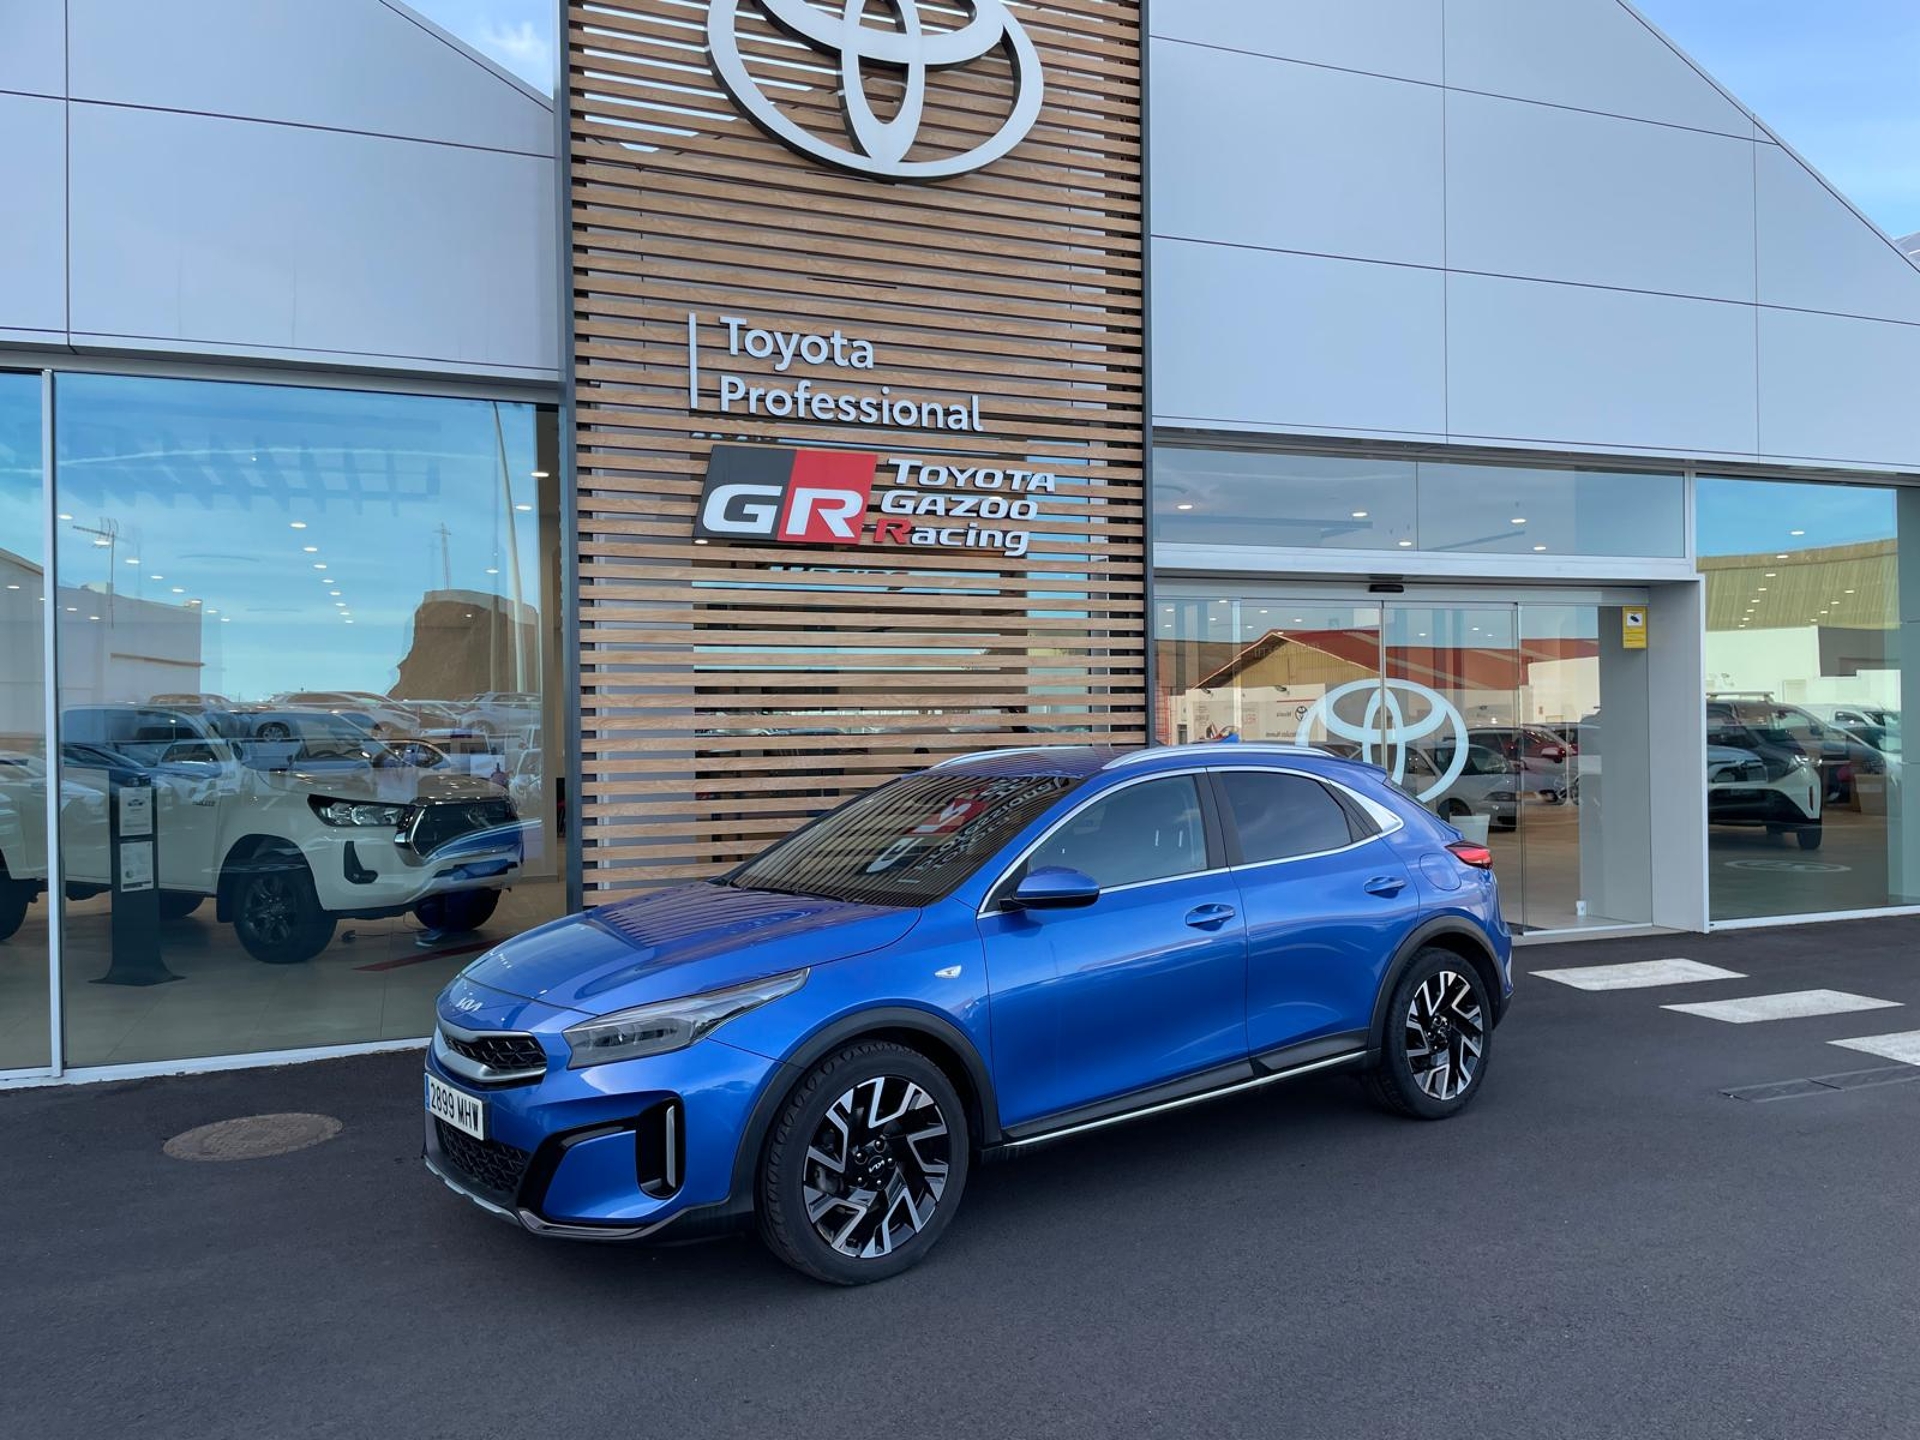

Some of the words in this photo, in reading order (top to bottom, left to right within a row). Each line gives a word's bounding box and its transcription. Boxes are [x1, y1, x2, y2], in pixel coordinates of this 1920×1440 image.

[719, 316, 875, 372] Toyota
[719, 375, 984, 432] Professional
[887, 458, 1056, 492] TOYOTA
[702, 484, 864, 538] GR
[880, 490, 1039, 521] GAZOO
[873, 518, 1031, 558] Racing
[455, 996, 483, 1012] KIA
[430, 1082, 455, 1119] 2899
[456, 1095, 479, 1132] MHW
